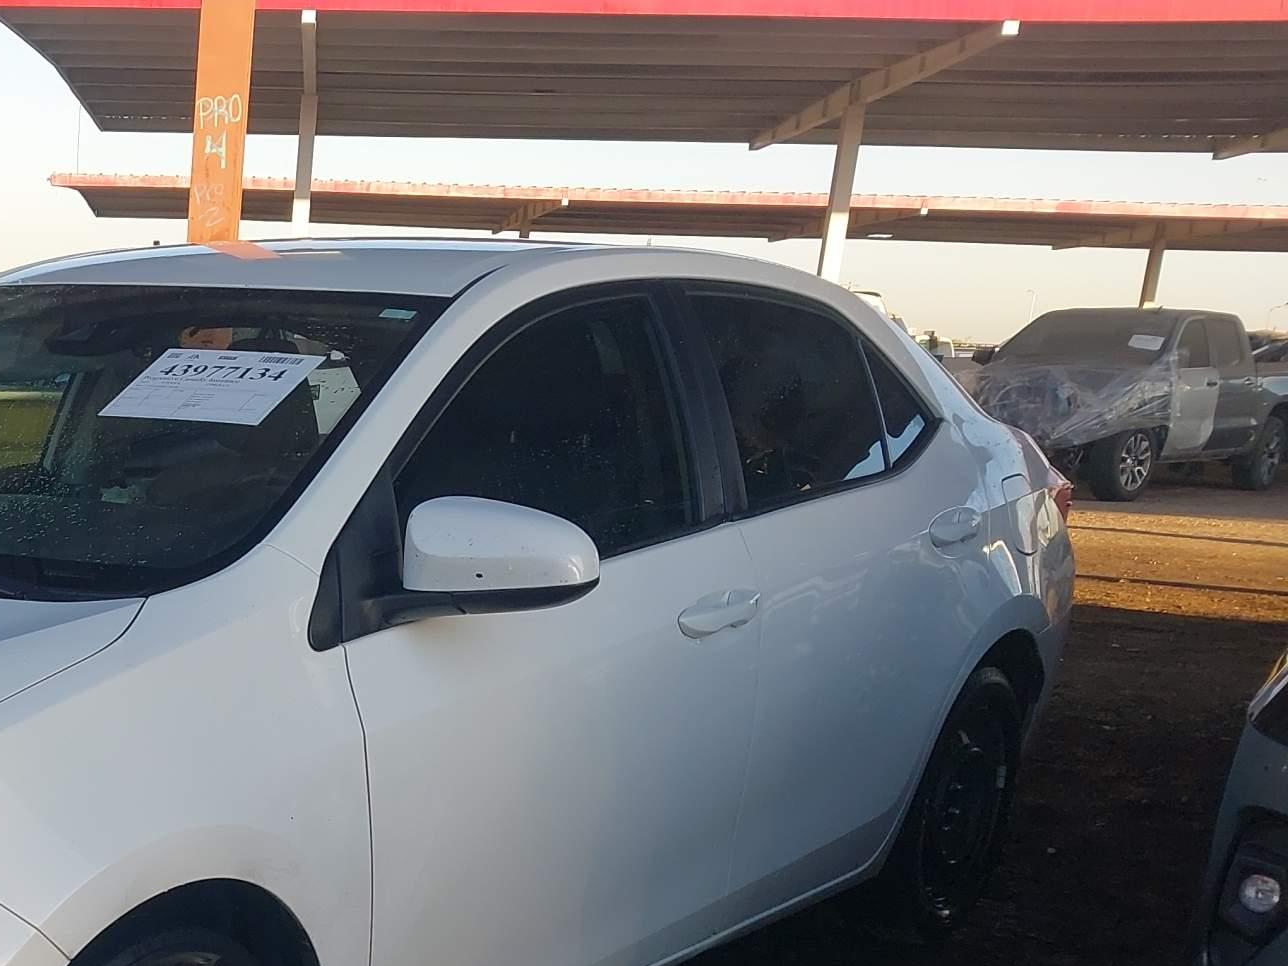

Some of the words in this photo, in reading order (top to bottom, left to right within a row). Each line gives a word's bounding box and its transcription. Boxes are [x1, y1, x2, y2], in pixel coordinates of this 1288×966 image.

[196, 94, 243, 128] PRO
[204, 130, 228, 169] 4
[159, 363, 289, 382] 43977134
